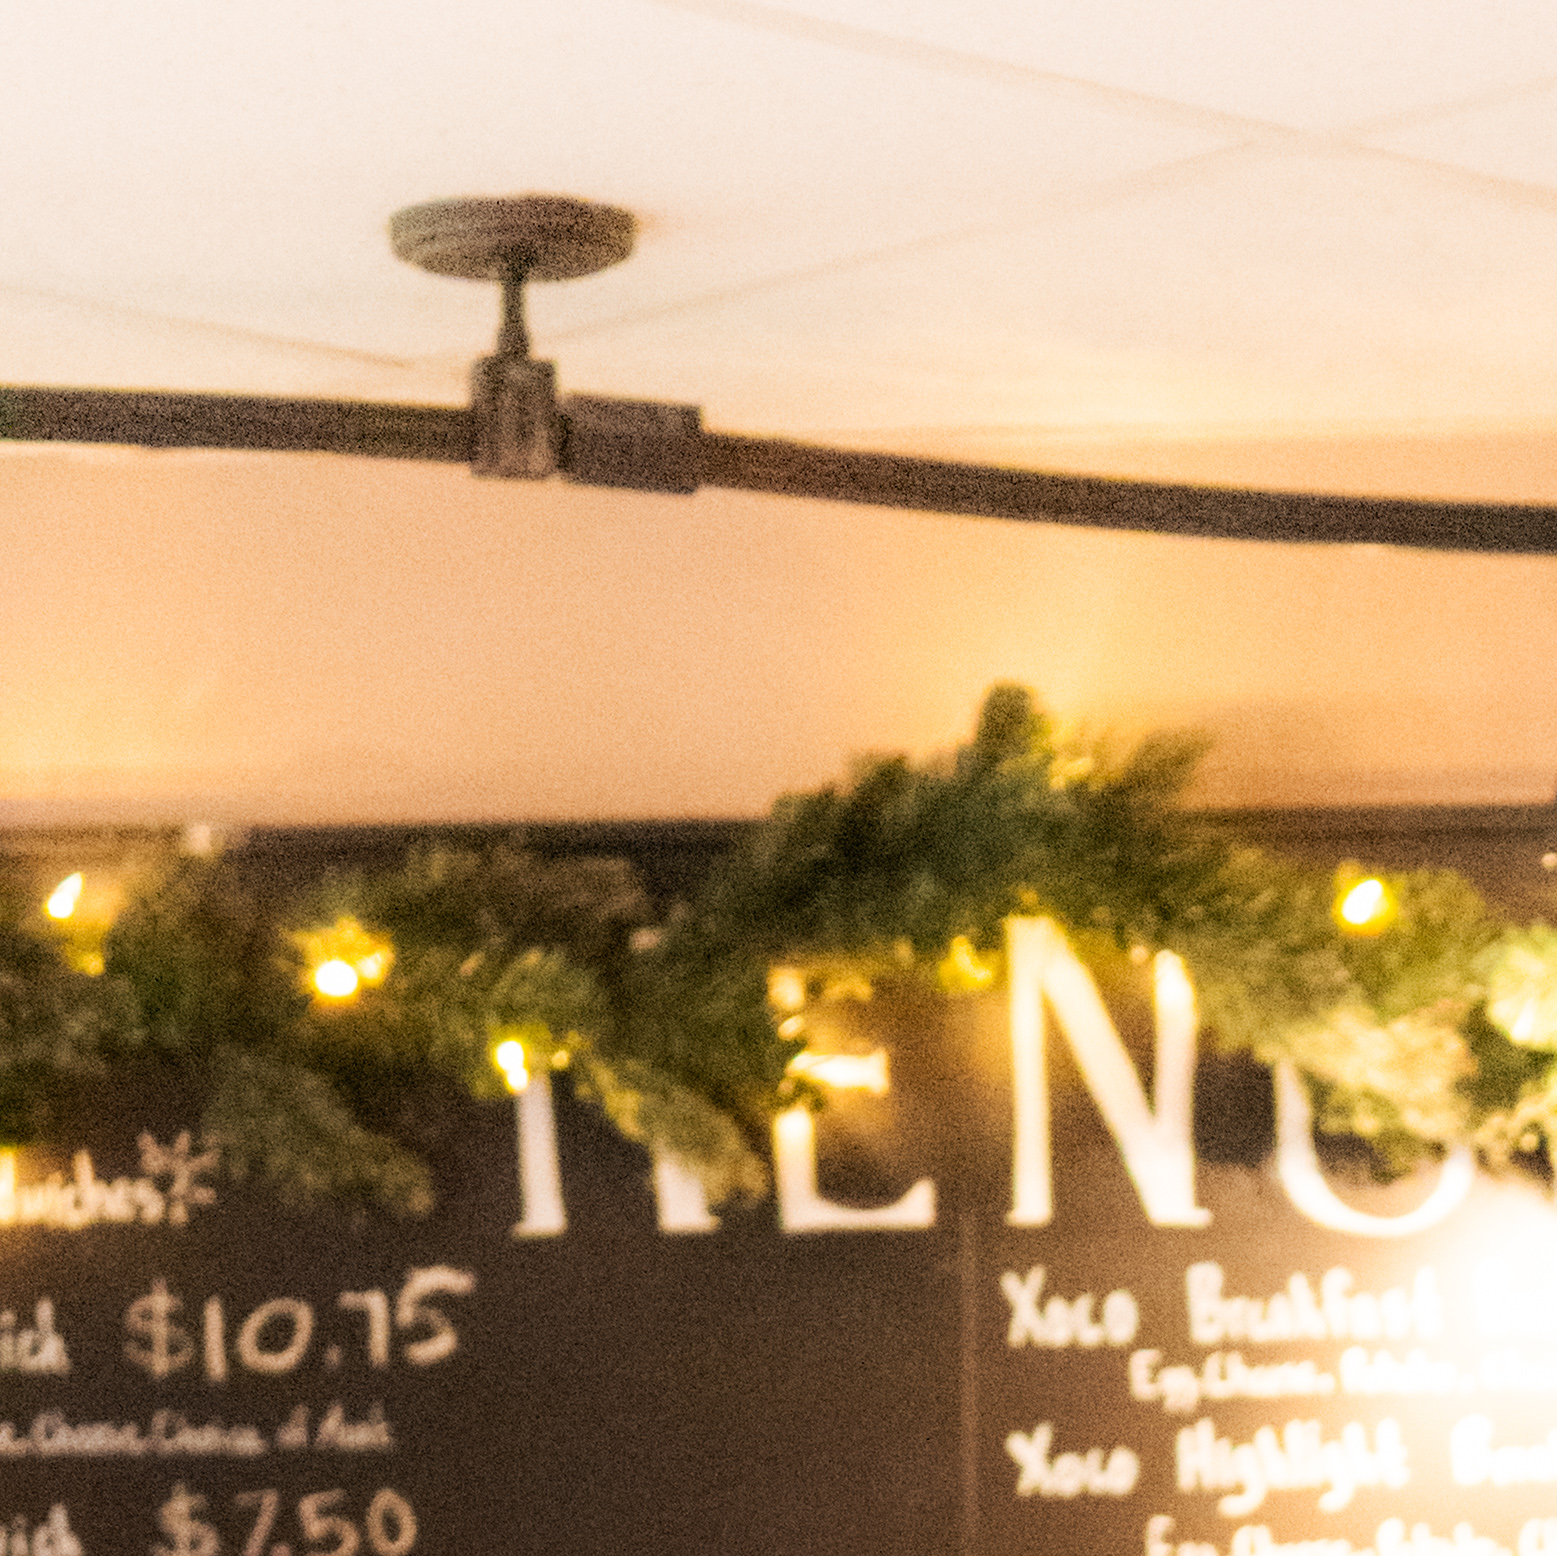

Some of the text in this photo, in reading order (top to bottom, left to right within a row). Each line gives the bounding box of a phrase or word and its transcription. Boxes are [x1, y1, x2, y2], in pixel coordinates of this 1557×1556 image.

[508, 915, 1476, 1239] ENU
[122, 1265, 475, 1384] $10.75
[1000, 1263, 1139, 1349] Xoco
[1005, 1422, 1140, 1499] Xoco
